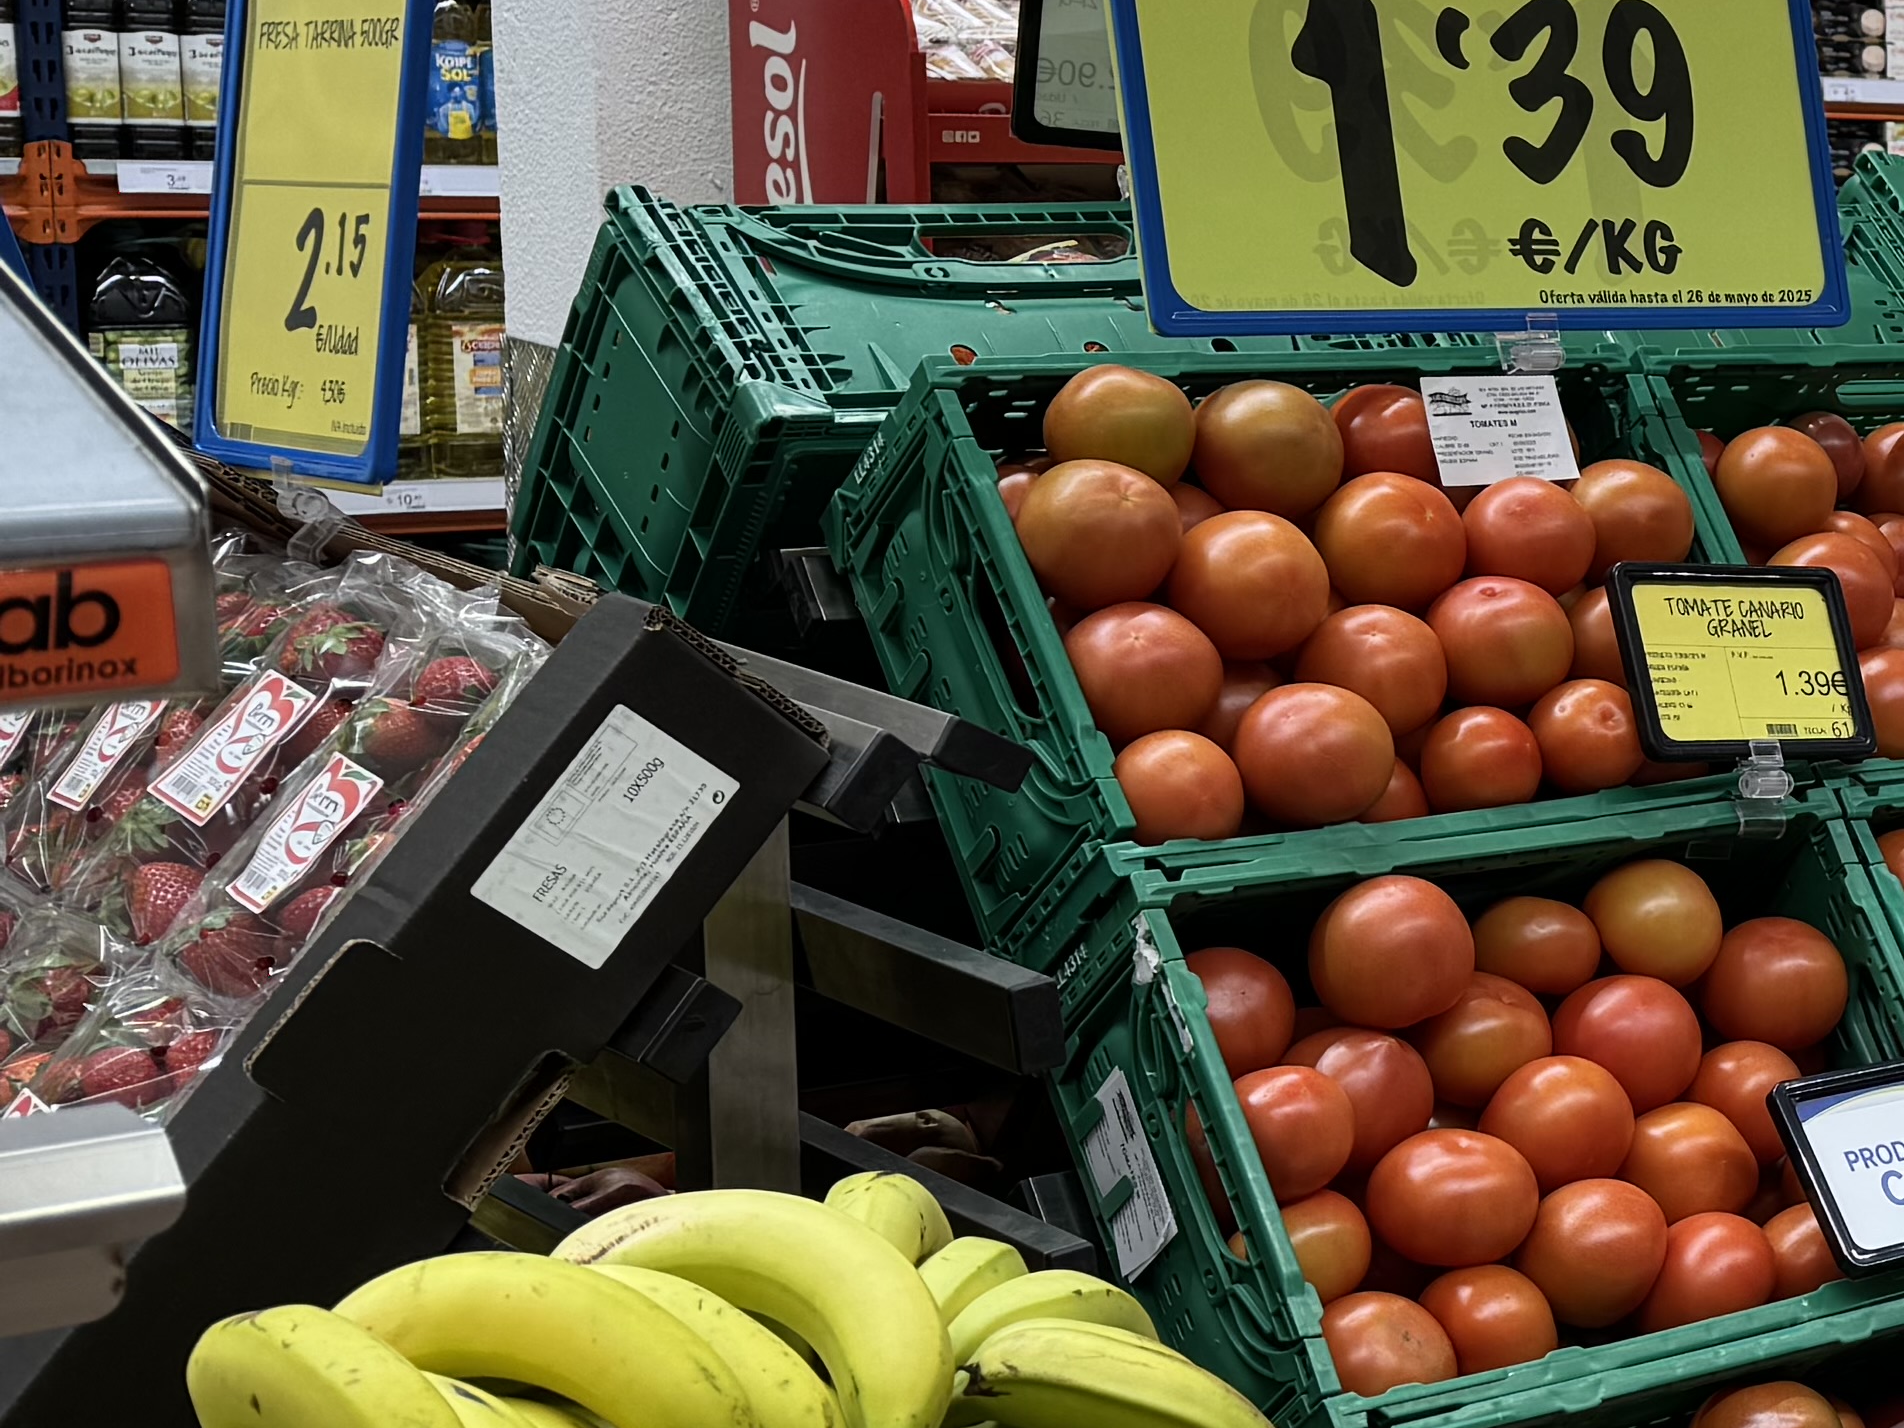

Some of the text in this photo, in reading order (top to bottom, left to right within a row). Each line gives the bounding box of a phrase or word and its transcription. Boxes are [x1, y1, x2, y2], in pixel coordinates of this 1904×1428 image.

[260, 16, 399, 50] FRESA TARRINA 500GR
[1507, 218, 1682, 274] €/KG
[1539, 288, 1812, 307] Oferta válida hasta el 26 de mayo de 2025
[251, 372, 278, 397] Precio
[1470, 420, 1508, 428] TOMATES
[1664, 597, 1804, 619] TOMATE CANARIO
[1707, 619, 1772, 638] GRANEL
[0, 656, 138, 689] lborinox
[1776, 670, 1849, 696] 1.39€
[1832, 721, 1849, 738] 61
[623, 757, 665, 803] 10X500g
[532, 863, 567, 903] FRESAS
